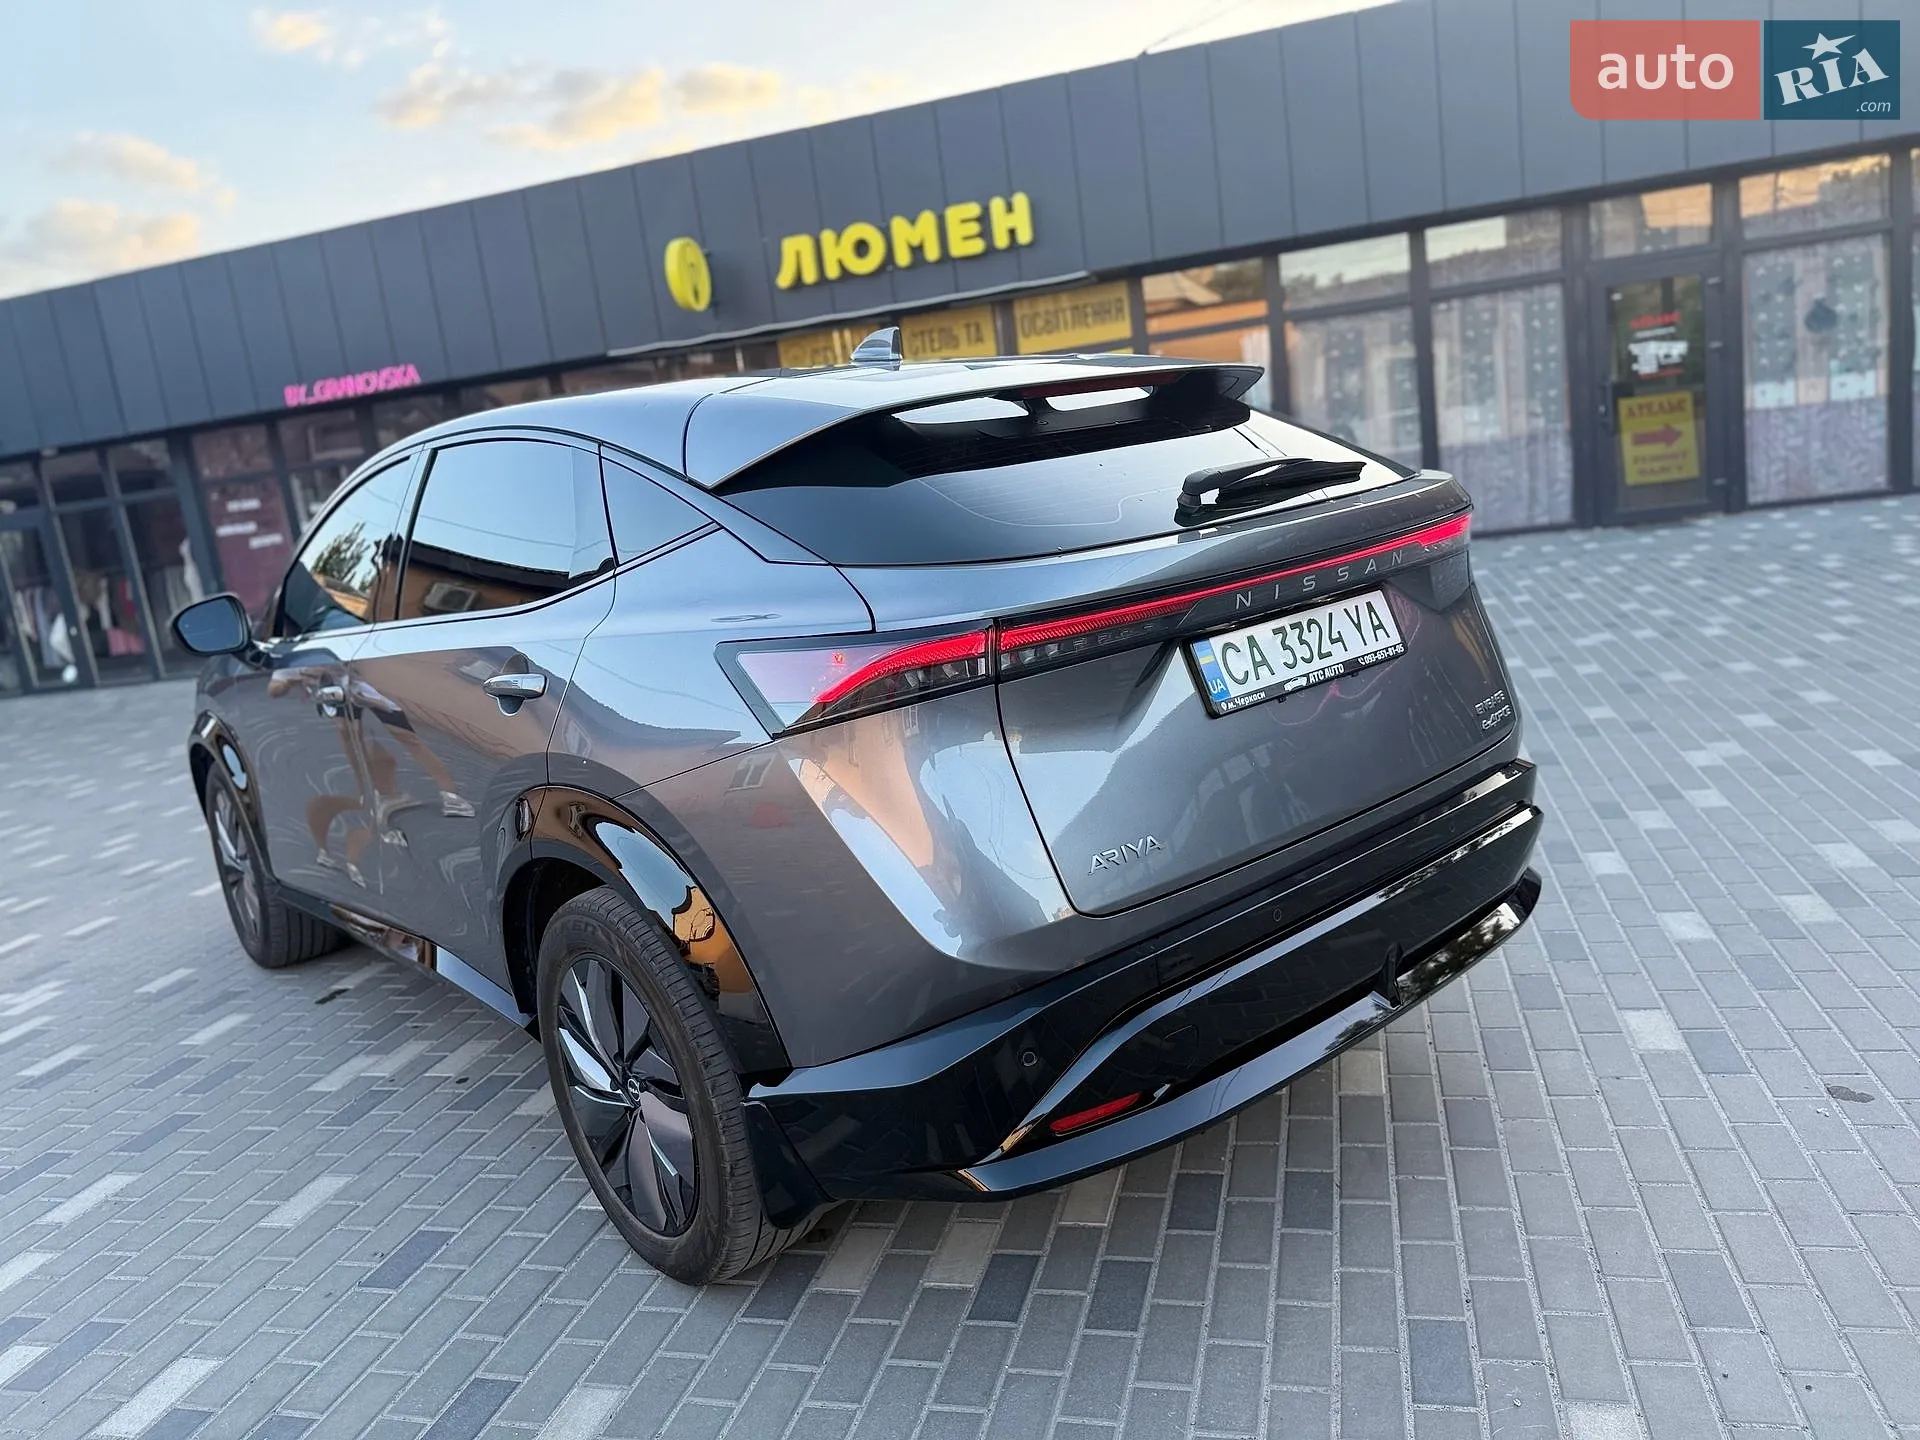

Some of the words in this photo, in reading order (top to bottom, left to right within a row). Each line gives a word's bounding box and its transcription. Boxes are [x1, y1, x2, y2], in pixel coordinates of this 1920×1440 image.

[775, 191, 1034, 291] ЛЮМЕН
[1236, 551, 1404, 609] NISSAN
[1221, 634, 1276, 686] CA
[1272, 612, 1348, 670] 3324
[1343, 601, 1391, 647] YA
[1207, 679, 1227, 695] UA
[1323, 663, 1345, 681] AUTO
[1088, 834, 1163, 876] ARIYA
